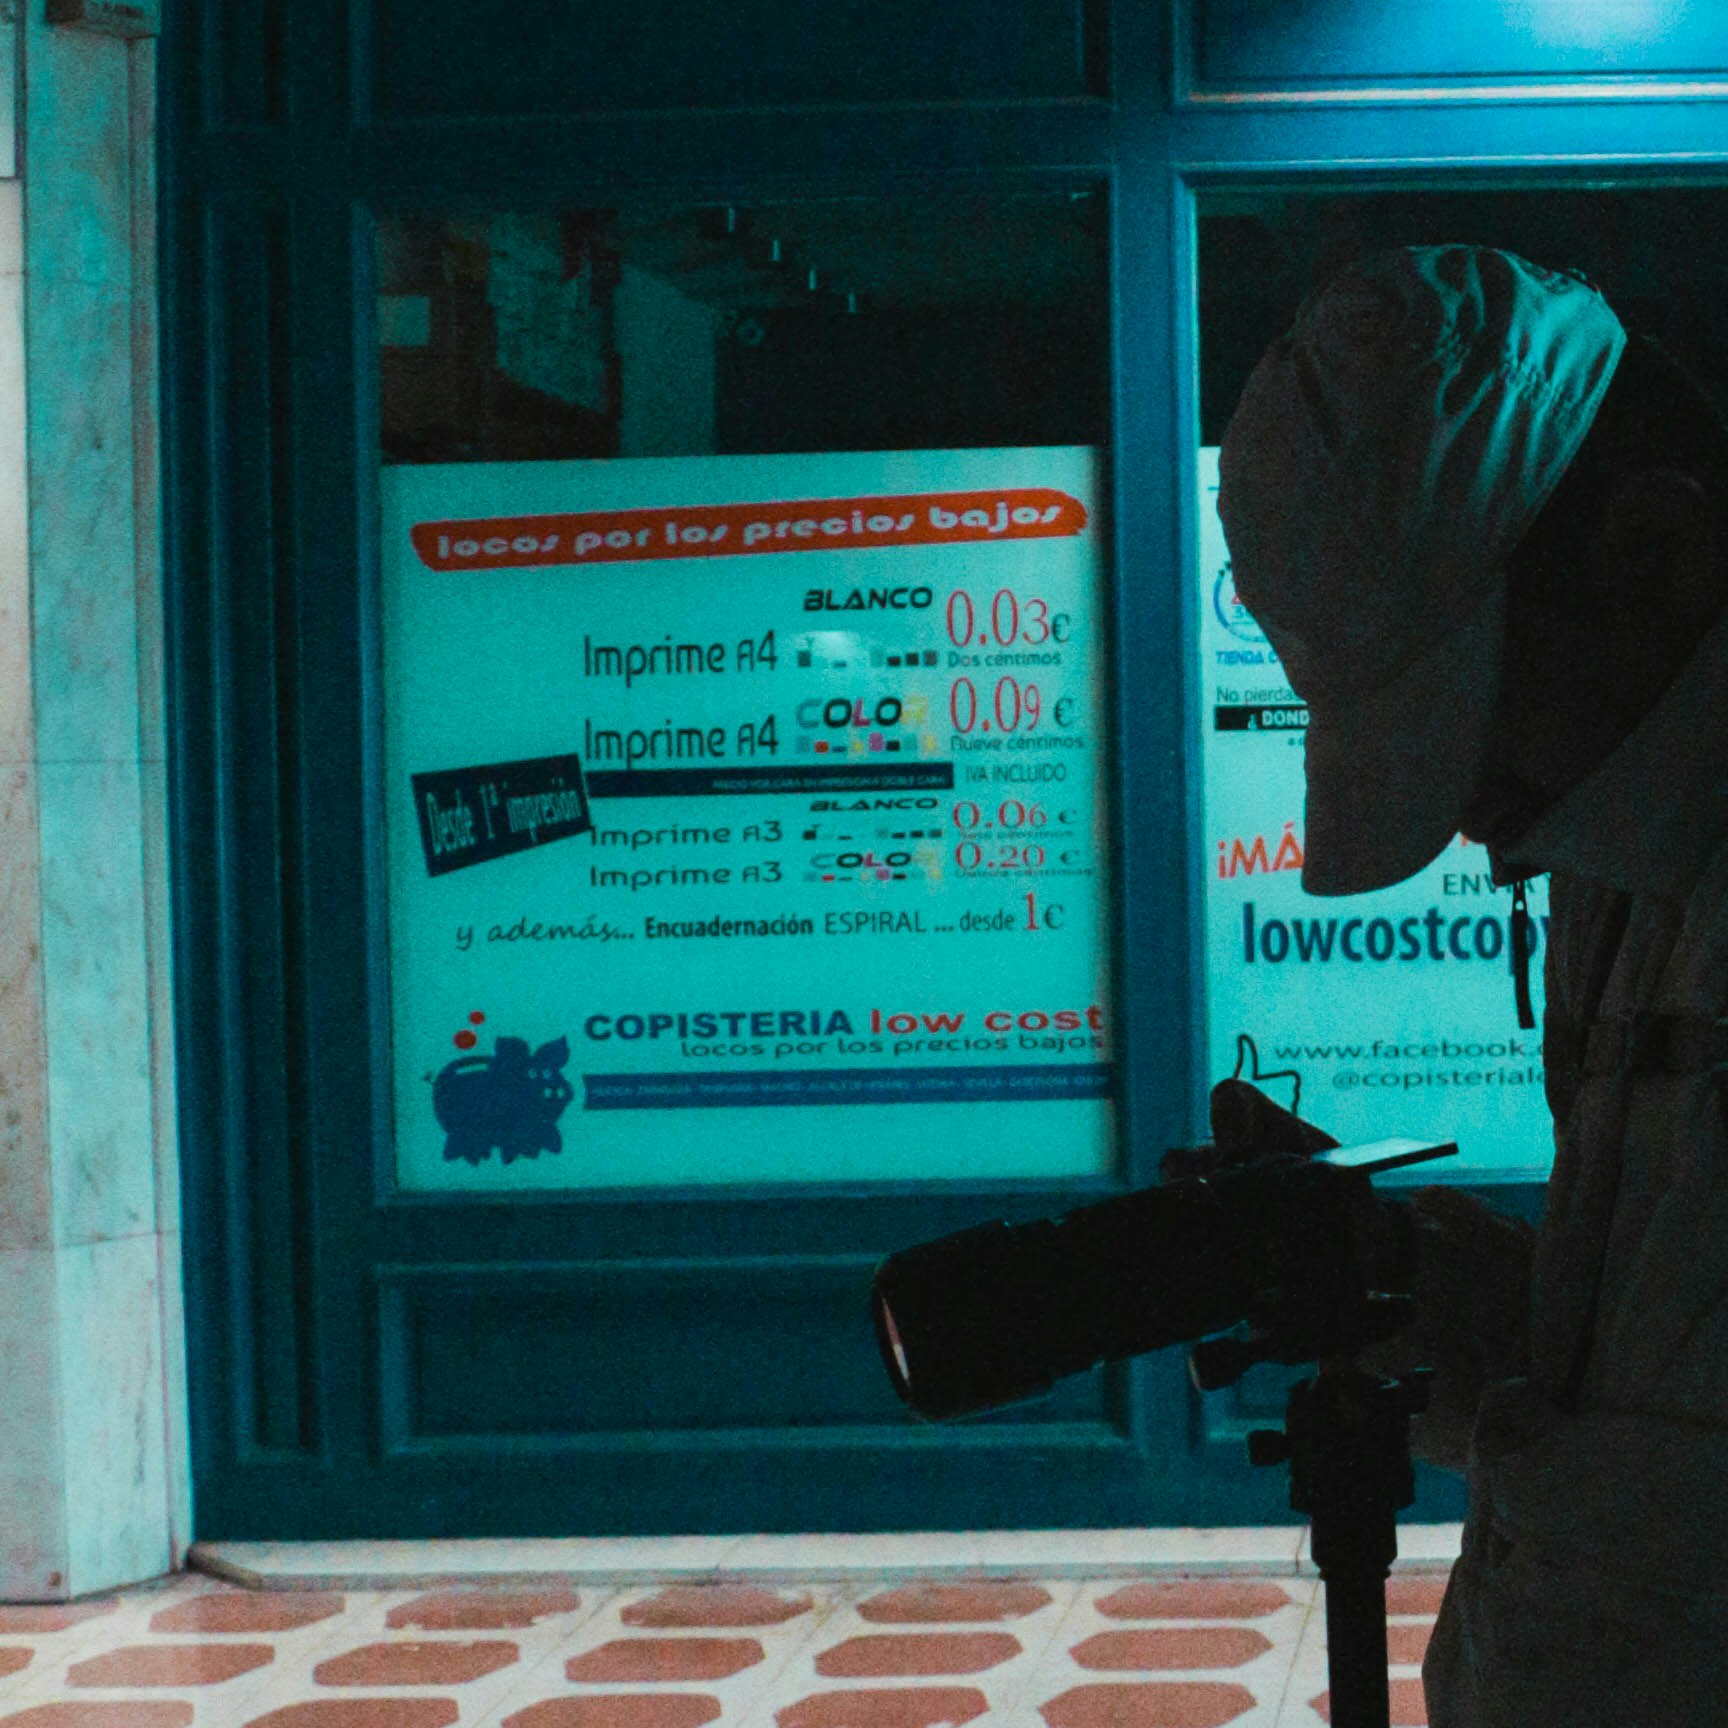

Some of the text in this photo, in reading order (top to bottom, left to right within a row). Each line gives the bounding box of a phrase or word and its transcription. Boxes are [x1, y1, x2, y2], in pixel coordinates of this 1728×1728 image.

[437, 500, 1061, 559] locos por los precios bajos
[803, 586, 933, 612] BLANCO
[584, 633, 726, 689] Imprime
[736, 629, 778, 673] A4
[946, 651, 981, 669] Dos
[1214, 649, 1265, 666] TIENDA
[950, 675, 1041, 734] 0.09
[1216, 685, 1239, 703] No
[584, 718, 726, 770] Imprime
[736, 713, 779, 758] A4
[992, 762, 1067, 783] INCLUIDO
[809, 797, 939, 813] BLANCO
[952, 799, 1048, 829] 0.06
[426, 788, 478, 857] Desde
[589, 822, 731, 851] Imprime
[741, 818, 784, 843] A3
[954, 841, 1046, 870] 0.20
[589, 864, 731, 892] Imprime
[741, 860, 784, 885] A3
[455, 924, 474, 953] y
[644, 913, 815, 940] Encuadernación
[823, 910, 928, 935] ESPIRAL
[959, 908, 1016, 933] desde
[1242, 900, 1550, 976] lowcostcop
[583, 1003, 1104, 1042] COPISTERIA low cost
[680, 1033, 1104, 1059] locos por los precios bajos
[1273, 1036, 1544, 1060] www.facebook.
